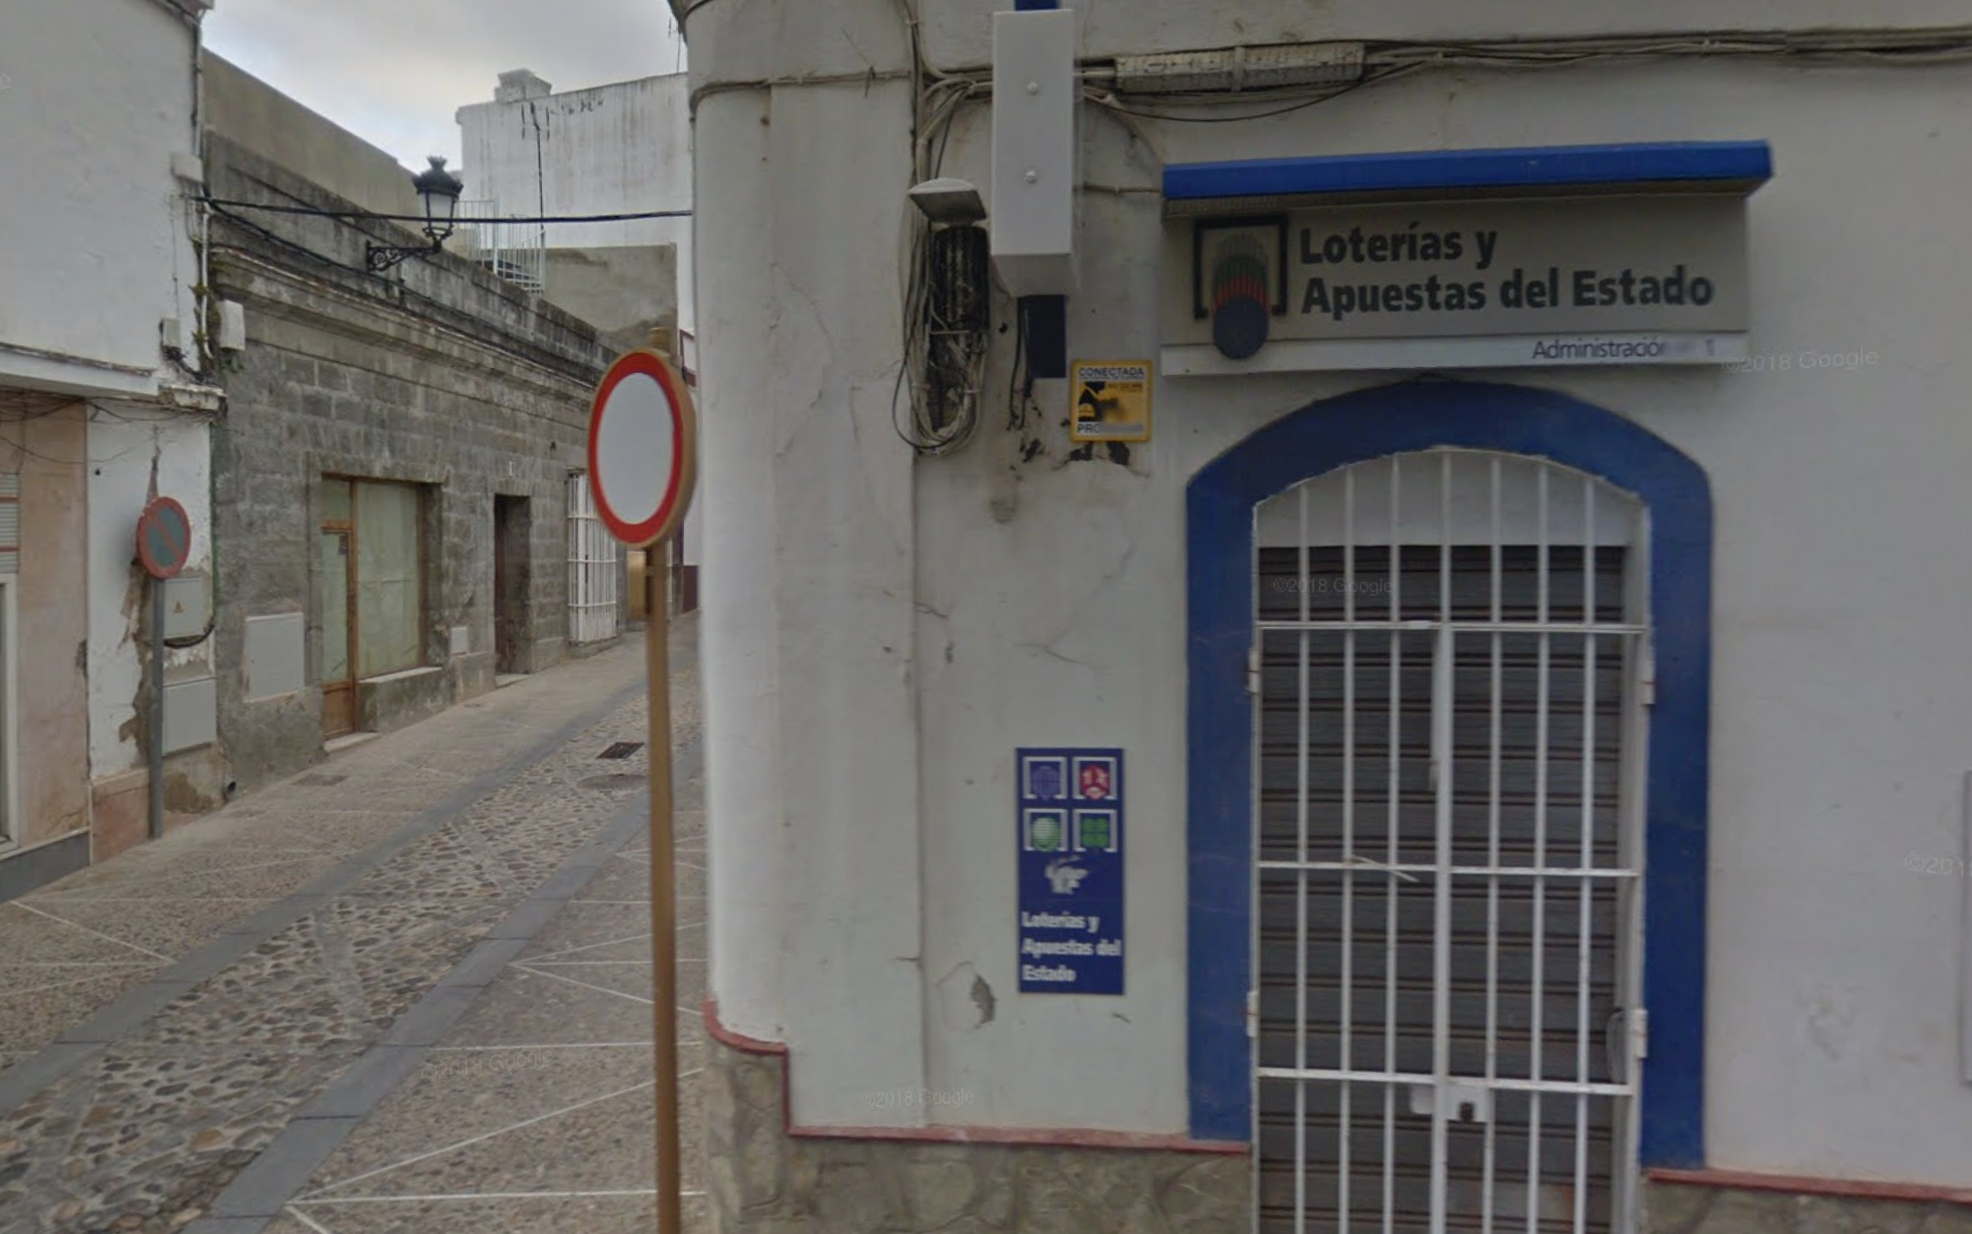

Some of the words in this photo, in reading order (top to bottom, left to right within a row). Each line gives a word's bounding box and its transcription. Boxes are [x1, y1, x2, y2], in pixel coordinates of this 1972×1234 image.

[1299, 221, 1463, 264] Loterías
[1474, 230, 1498, 270] y
[1301, 275, 1487, 321] Apuestas
[1500, 267, 1560, 308] del
[1572, 264, 1715, 306] Estado
[1078, 367, 1145, 377] CONECTADA
[1022, 937, 1093, 959] Apuestas
[1095, 937, 1121, 956] del
[1022, 963, 1077, 982] Estado
